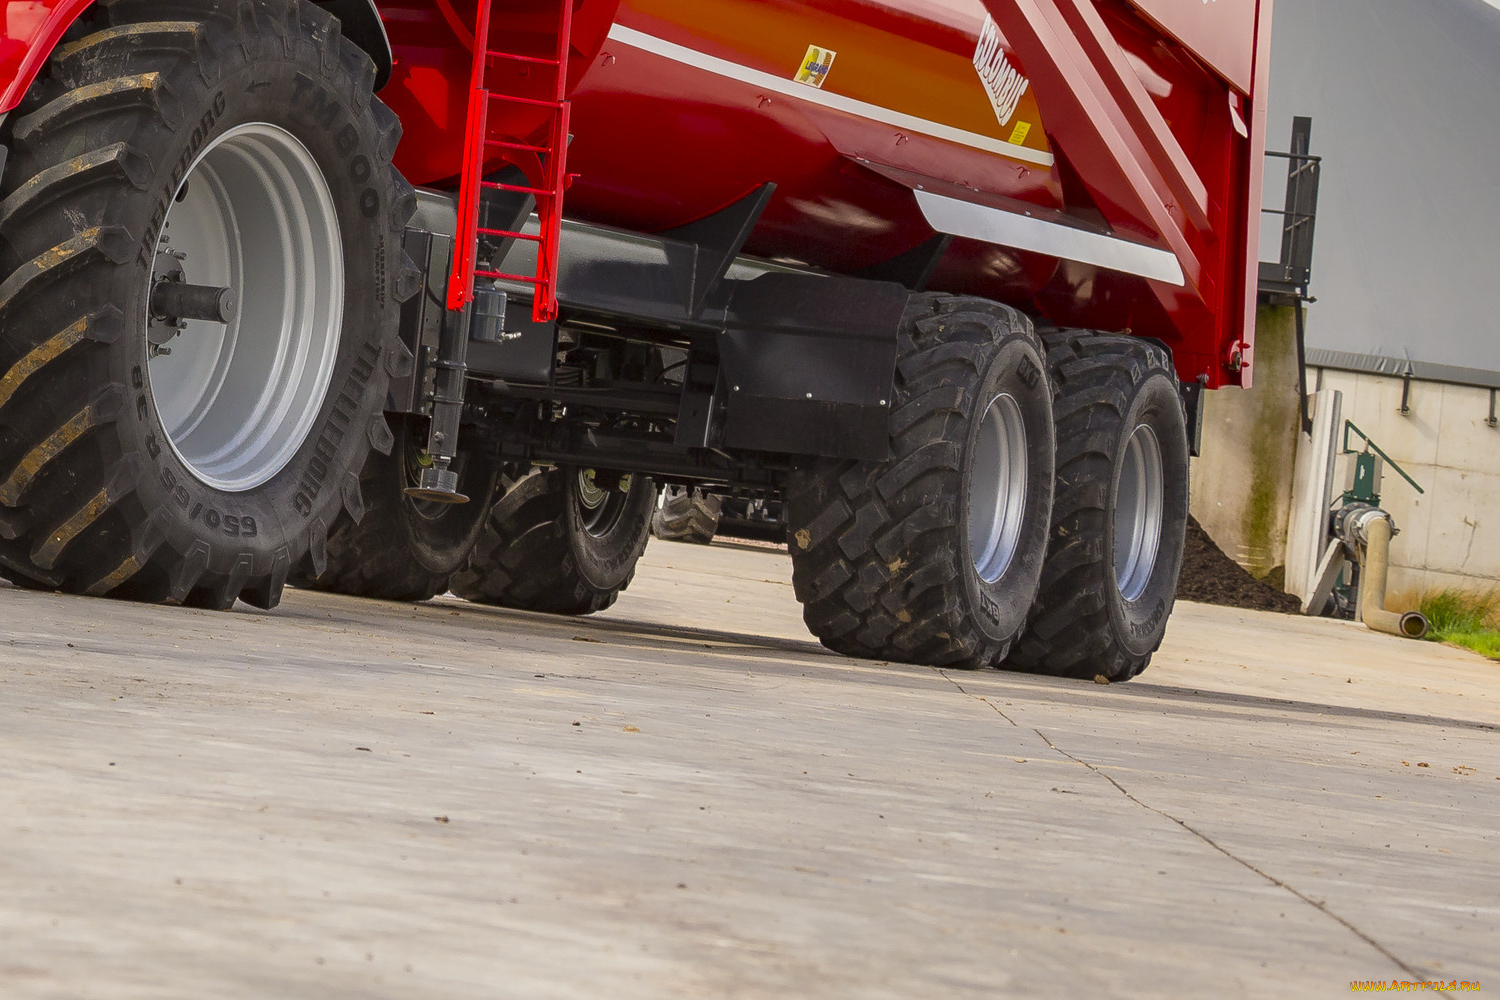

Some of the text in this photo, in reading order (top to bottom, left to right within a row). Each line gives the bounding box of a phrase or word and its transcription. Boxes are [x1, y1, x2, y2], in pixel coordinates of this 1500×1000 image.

[292, 72, 380, 219] TM800
[1017, 355, 1040, 388] BKT
[293, 340, 383, 517] TRELLEBORG
[159, 467, 258, 538] 650/65
